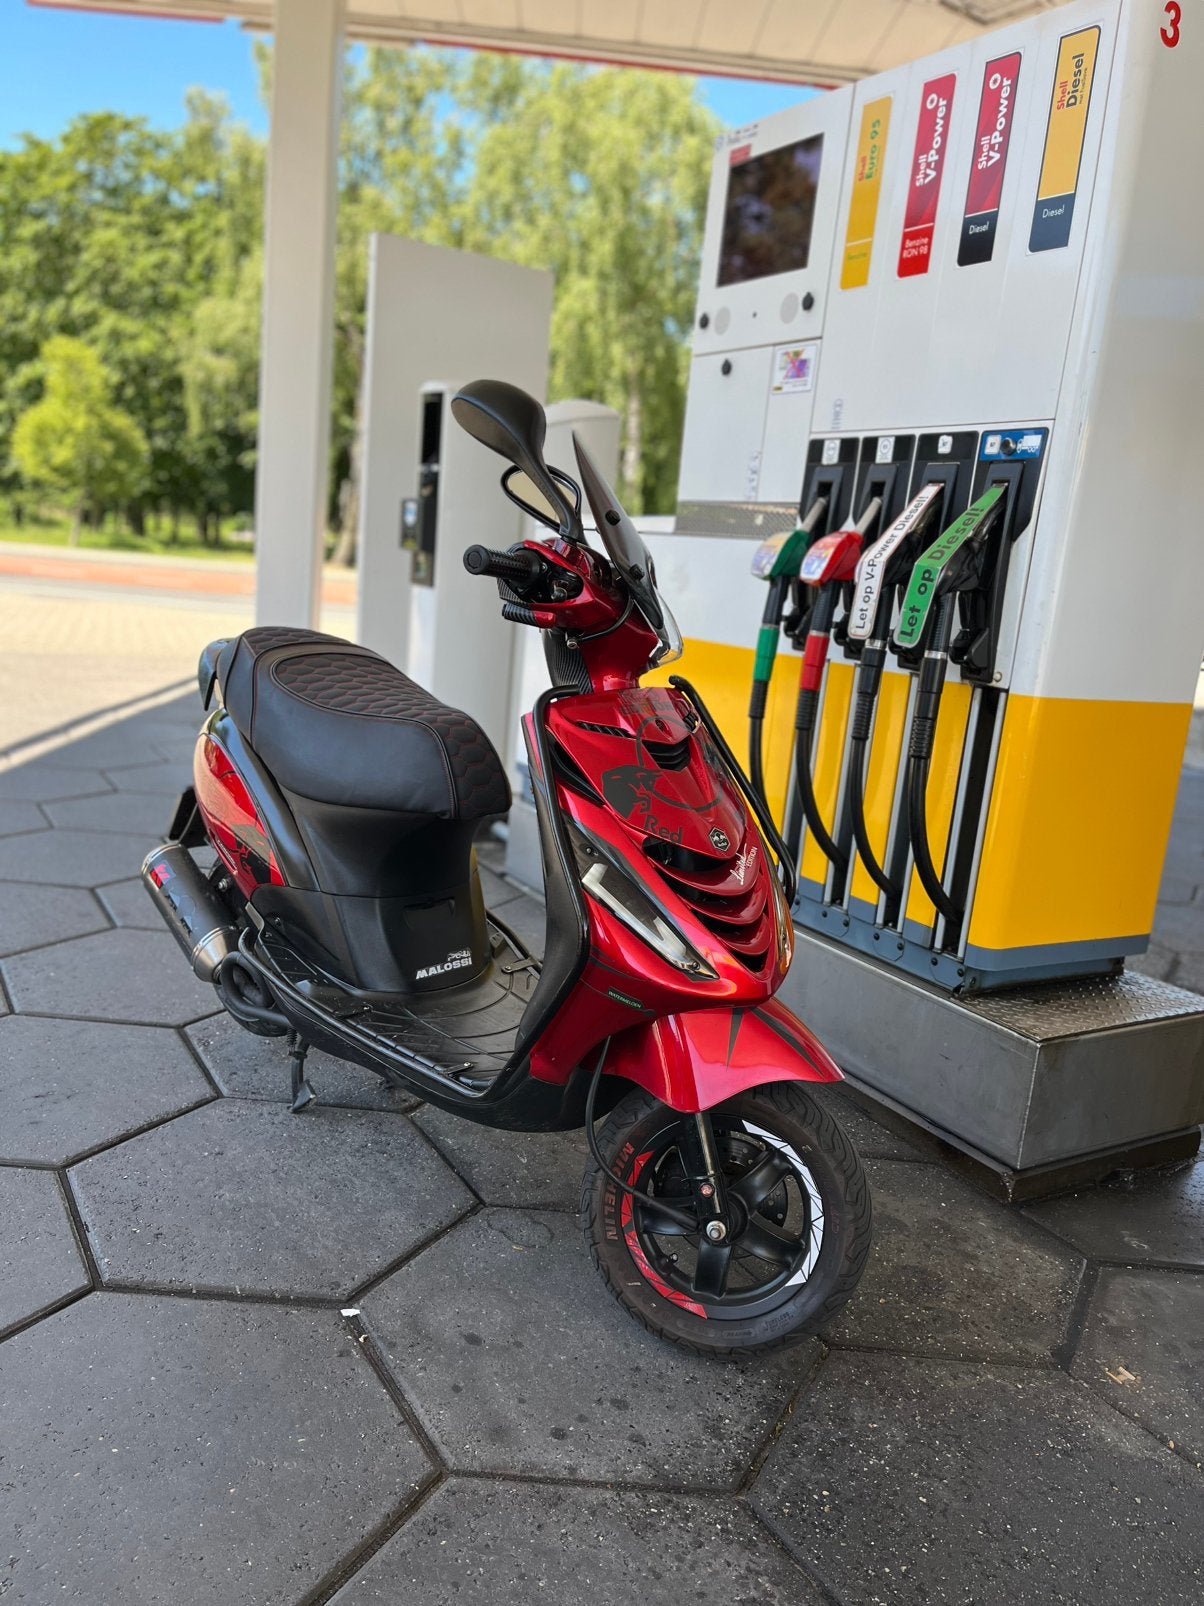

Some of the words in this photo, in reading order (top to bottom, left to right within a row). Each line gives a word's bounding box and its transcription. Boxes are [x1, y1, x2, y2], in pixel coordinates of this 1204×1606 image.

[1160, 1, 1181, 48] 3
[1057, 80, 1069, 110] Shell
[1066, 52, 1085, 108] Diesel
[869, 119, 881, 140] 95
[987, 77, 1012, 167] V-Power
[925, 98, 947, 185] V-Power
[978, 136, 990, 170] Shell
[858, 156, 868, 182] Shell
[865, 144, 878, 180] Euro
[916, 154, 927, 187] Shell
[1042, 205, 1065, 218] Diesel
[905, 237, 929, 248] Benzine
[968, 221, 989, 234] Diesel
[865, 534, 897, 581] V-Power
[900, 605, 921, 638] Let
[918, 568, 935, 595] op
[927, 507, 984, 561] Diesel!
[863, 586, 874, 603] op
[856, 608, 868, 629] Let
[644, 815, 682, 845] Red
[415, 957, 472, 980] MALOSSI
